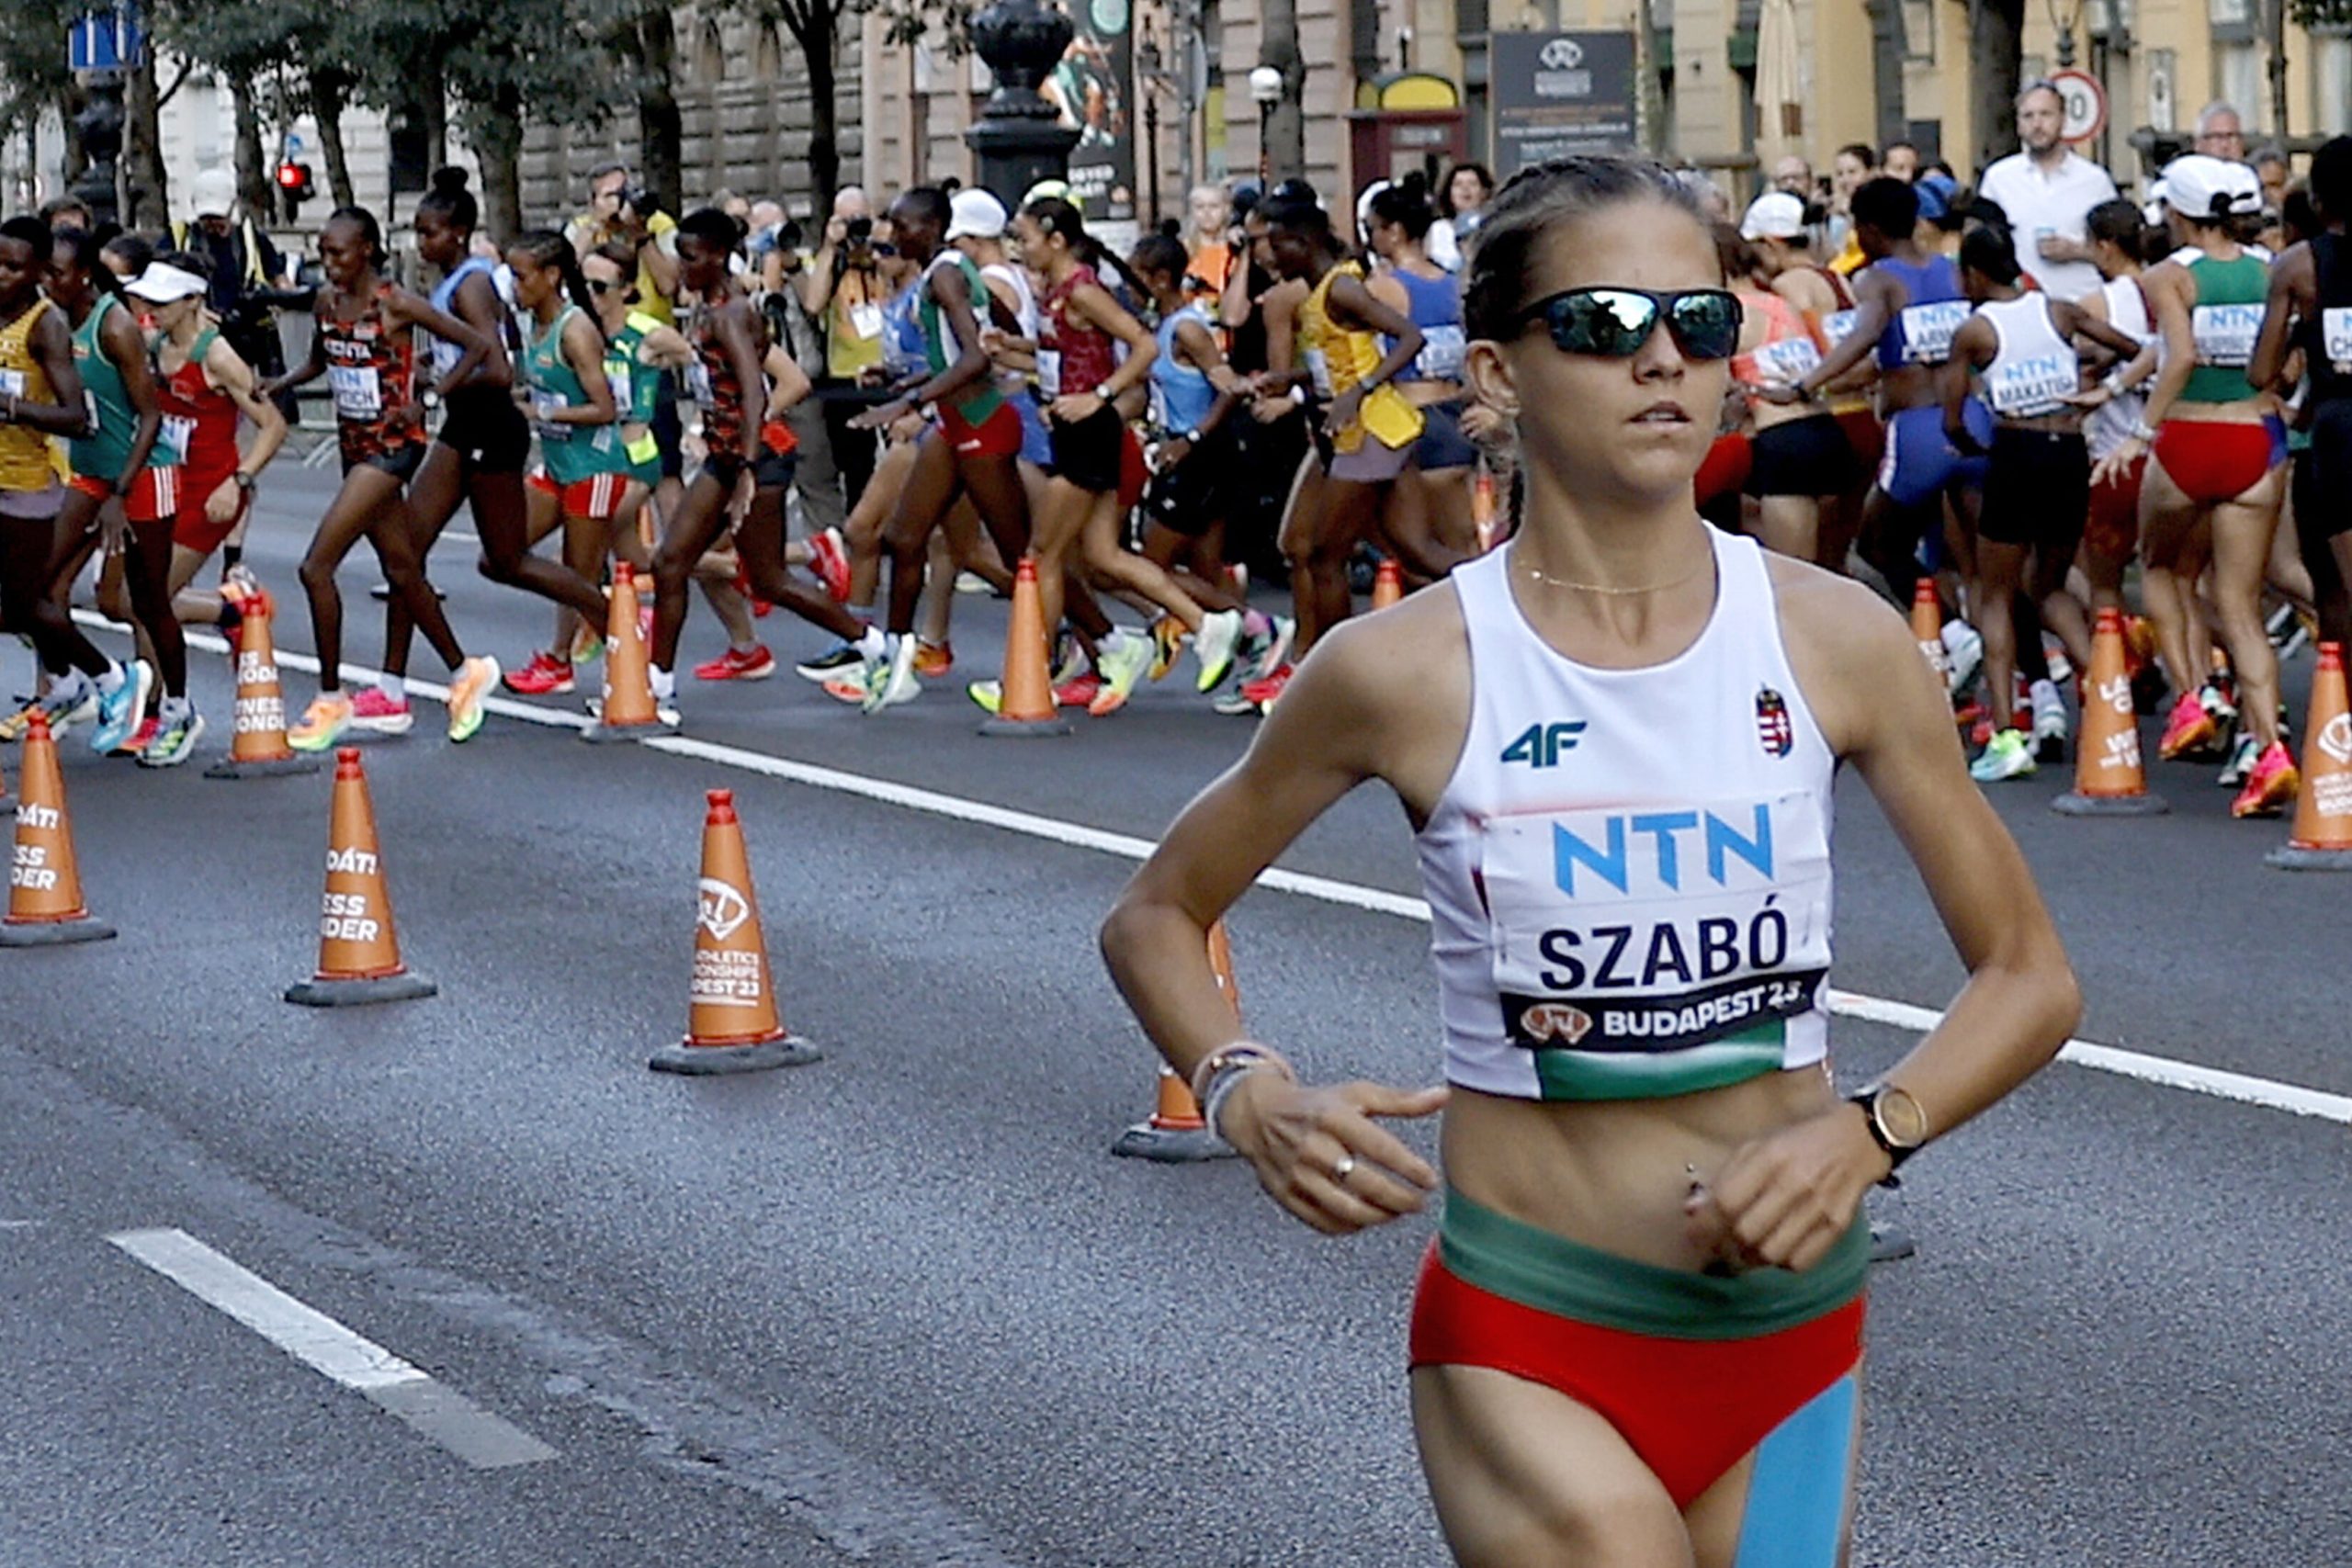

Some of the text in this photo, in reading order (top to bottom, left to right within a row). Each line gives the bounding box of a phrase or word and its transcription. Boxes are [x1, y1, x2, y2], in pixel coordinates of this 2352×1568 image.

[2006, 355, 2056, 379] NTN
[1553, 804, 1774, 898] NTN
[1539, 893, 1787, 991] SZABÓ
[1603, 987, 1767, 1037] BUDAPEST
